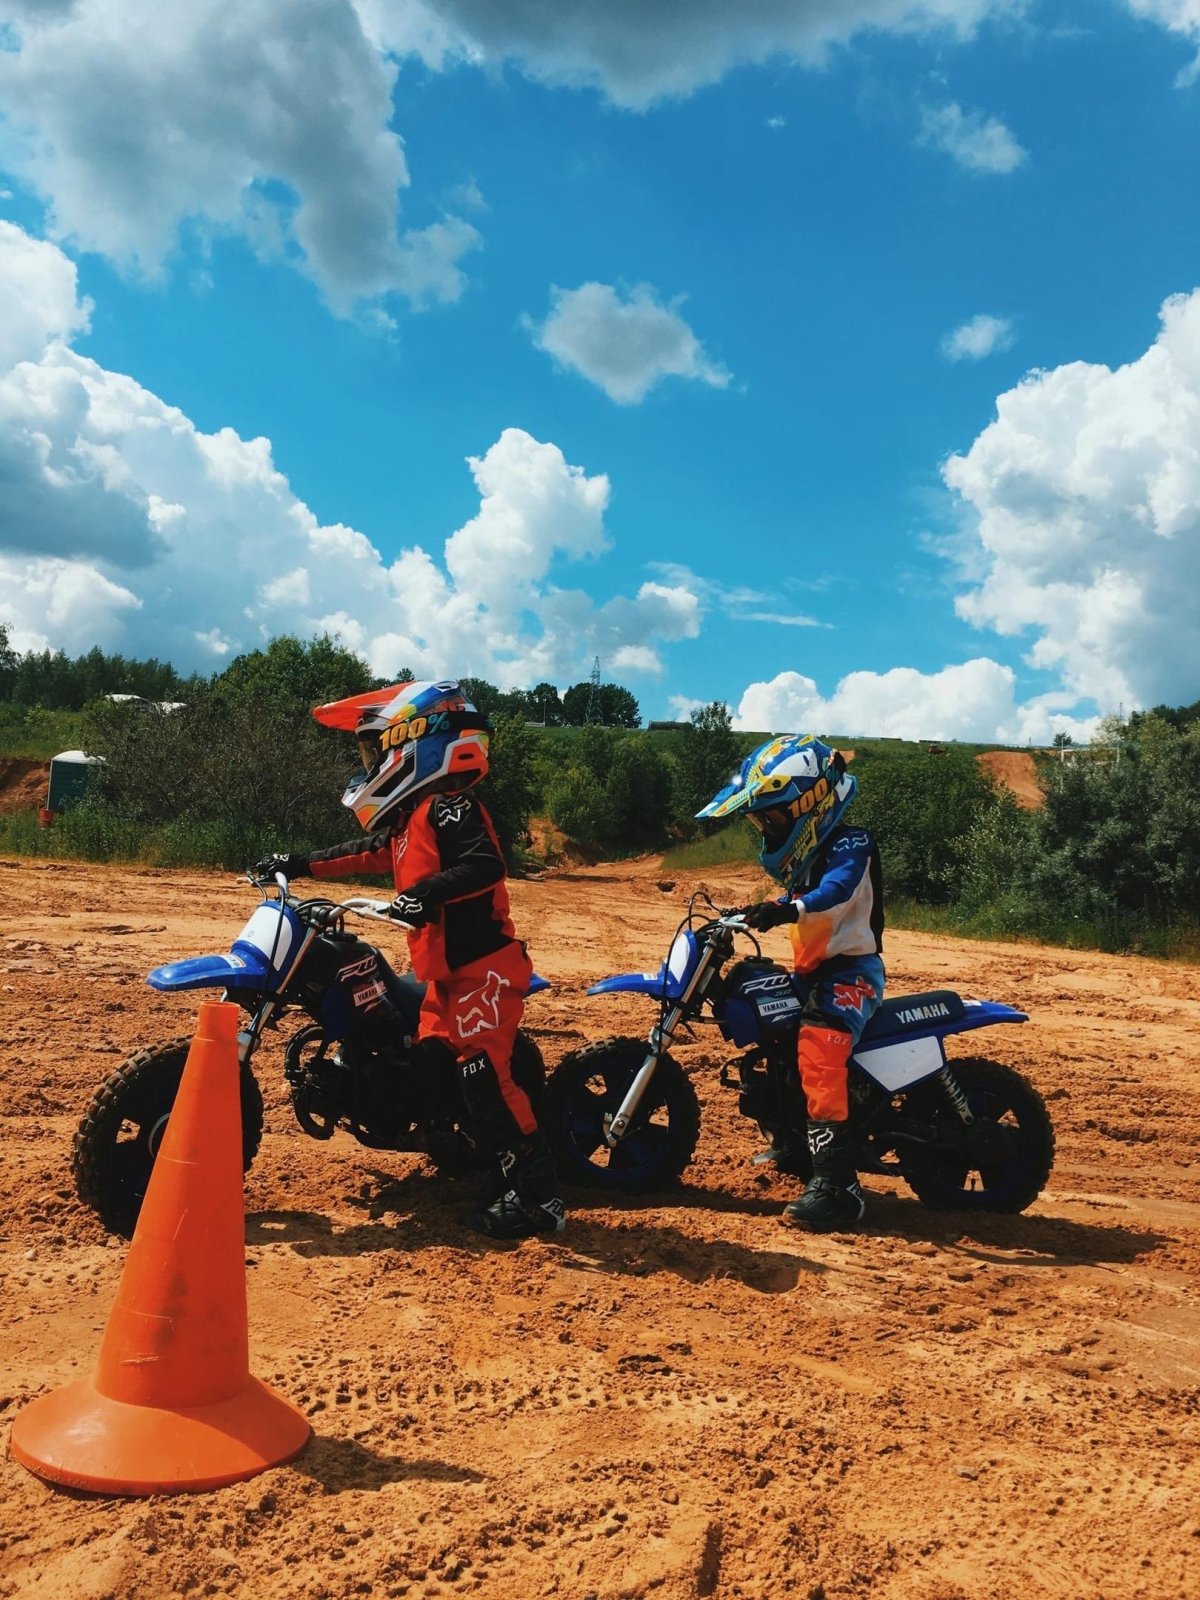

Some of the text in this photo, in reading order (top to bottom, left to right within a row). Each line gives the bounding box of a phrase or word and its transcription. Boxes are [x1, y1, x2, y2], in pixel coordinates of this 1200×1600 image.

[379, 711, 450, 752] 100%
[762, 1000, 789, 1013] YAMAHA
[895, 1002, 950, 1024] YAMAHA
[827, 1033, 849, 1046] FOX
[462, 1057, 486, 1077] FOX
